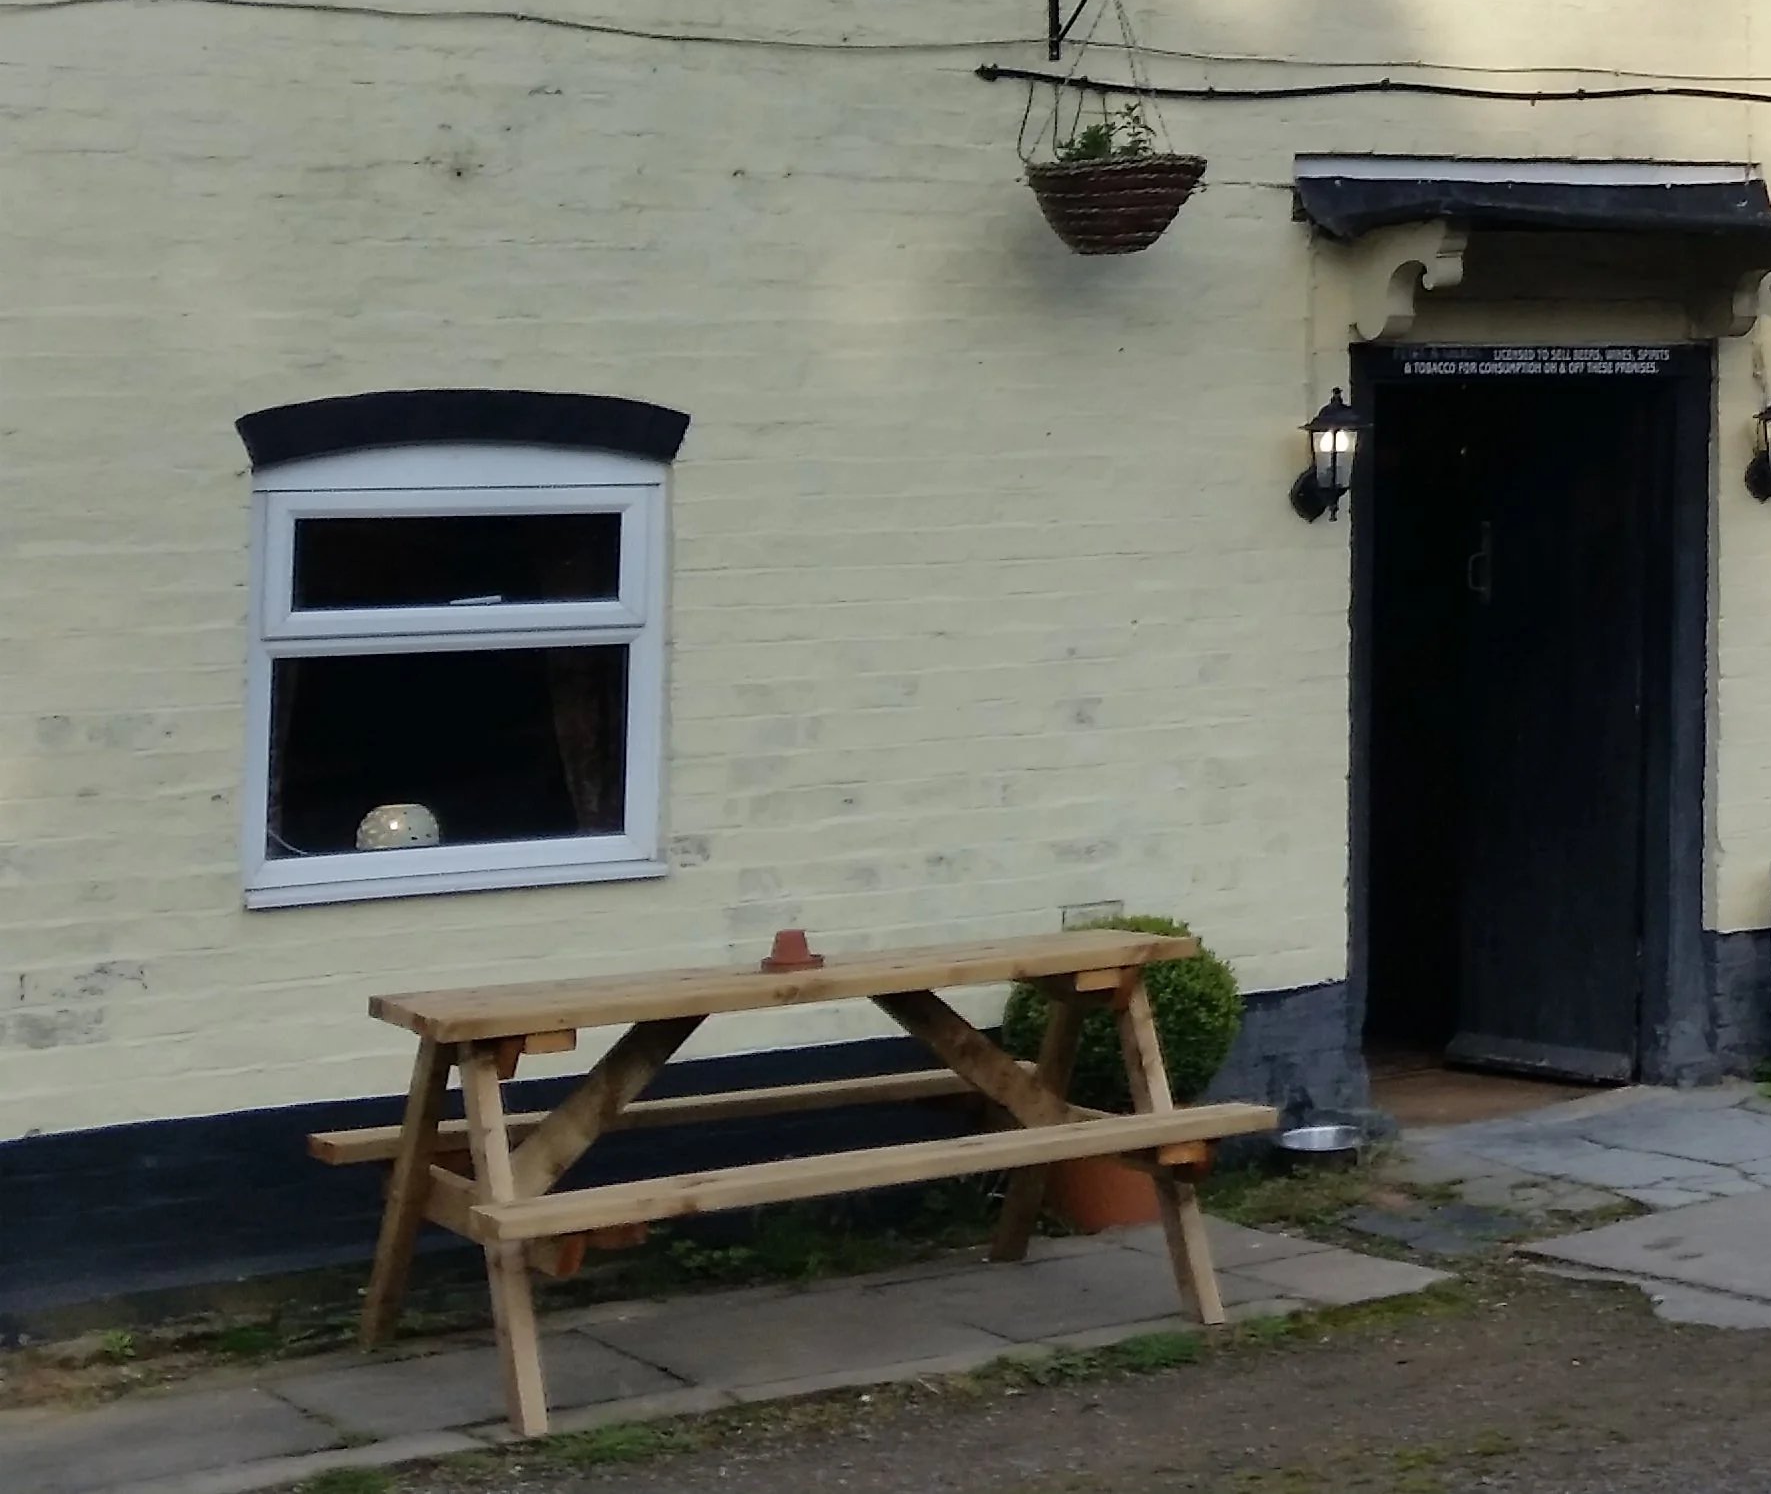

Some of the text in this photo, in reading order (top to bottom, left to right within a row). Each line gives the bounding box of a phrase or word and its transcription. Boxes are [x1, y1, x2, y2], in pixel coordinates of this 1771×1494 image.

[1537, 349, 1550, 361] TO
[1551, 349, 1571, 361] SELL
[1414, 362, 1456, 374] TOBACCO
[1458, 362, 1477, 374] FOR
[1479, 362, 1541, 374] CONSUMPTION
